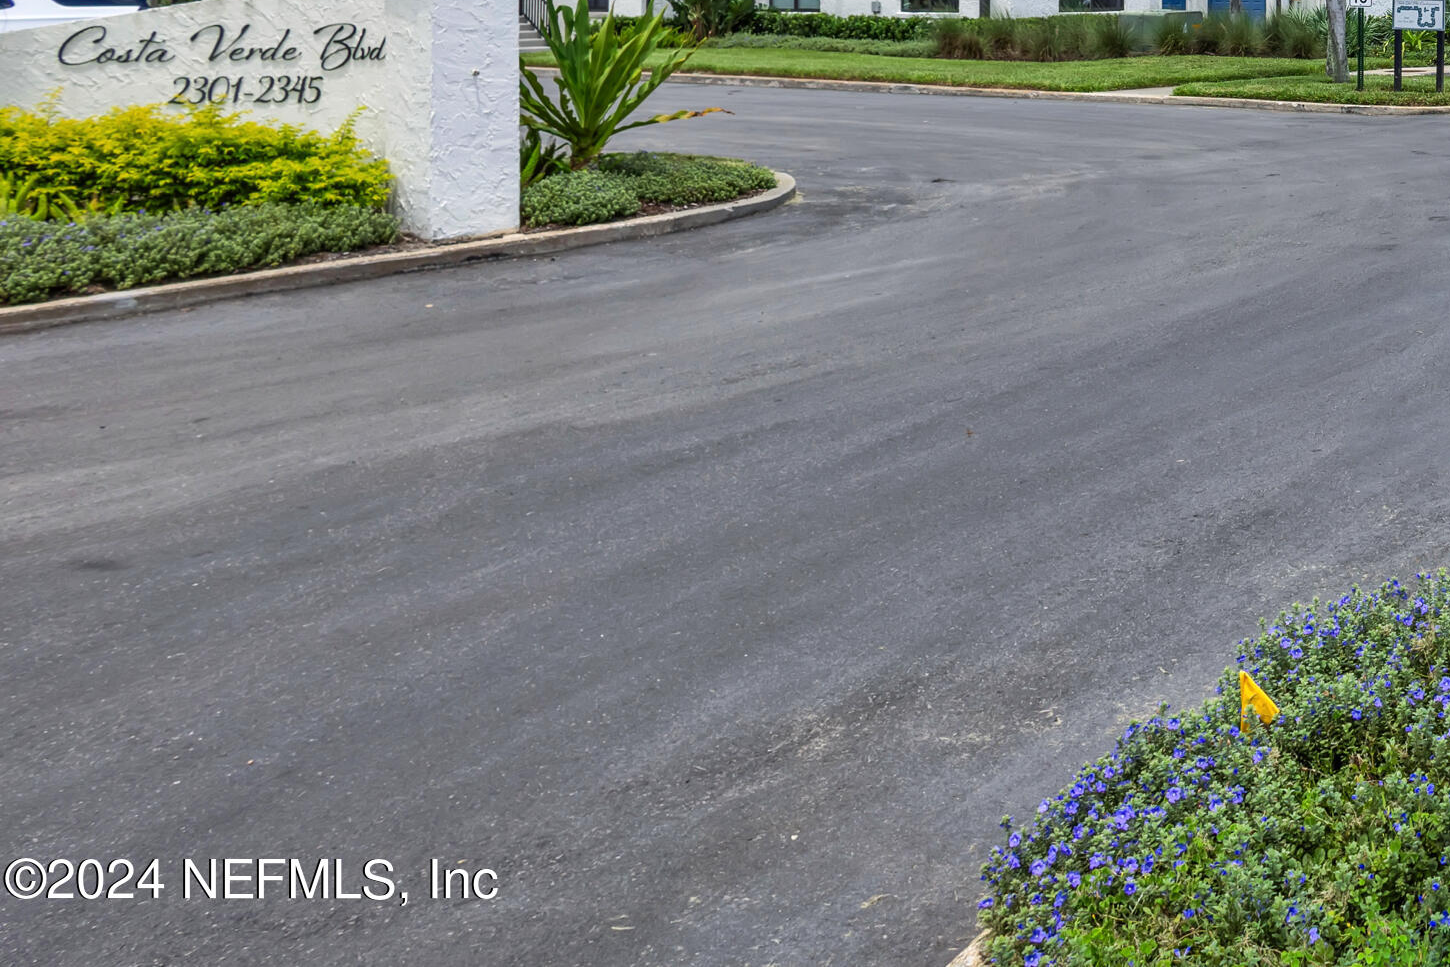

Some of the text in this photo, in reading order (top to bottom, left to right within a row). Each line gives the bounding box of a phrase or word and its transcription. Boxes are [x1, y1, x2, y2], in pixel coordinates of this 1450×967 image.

[57, 22, 387, 72] Costa Verde Blvd
[167, 75, 324, 105] 2301-2345
